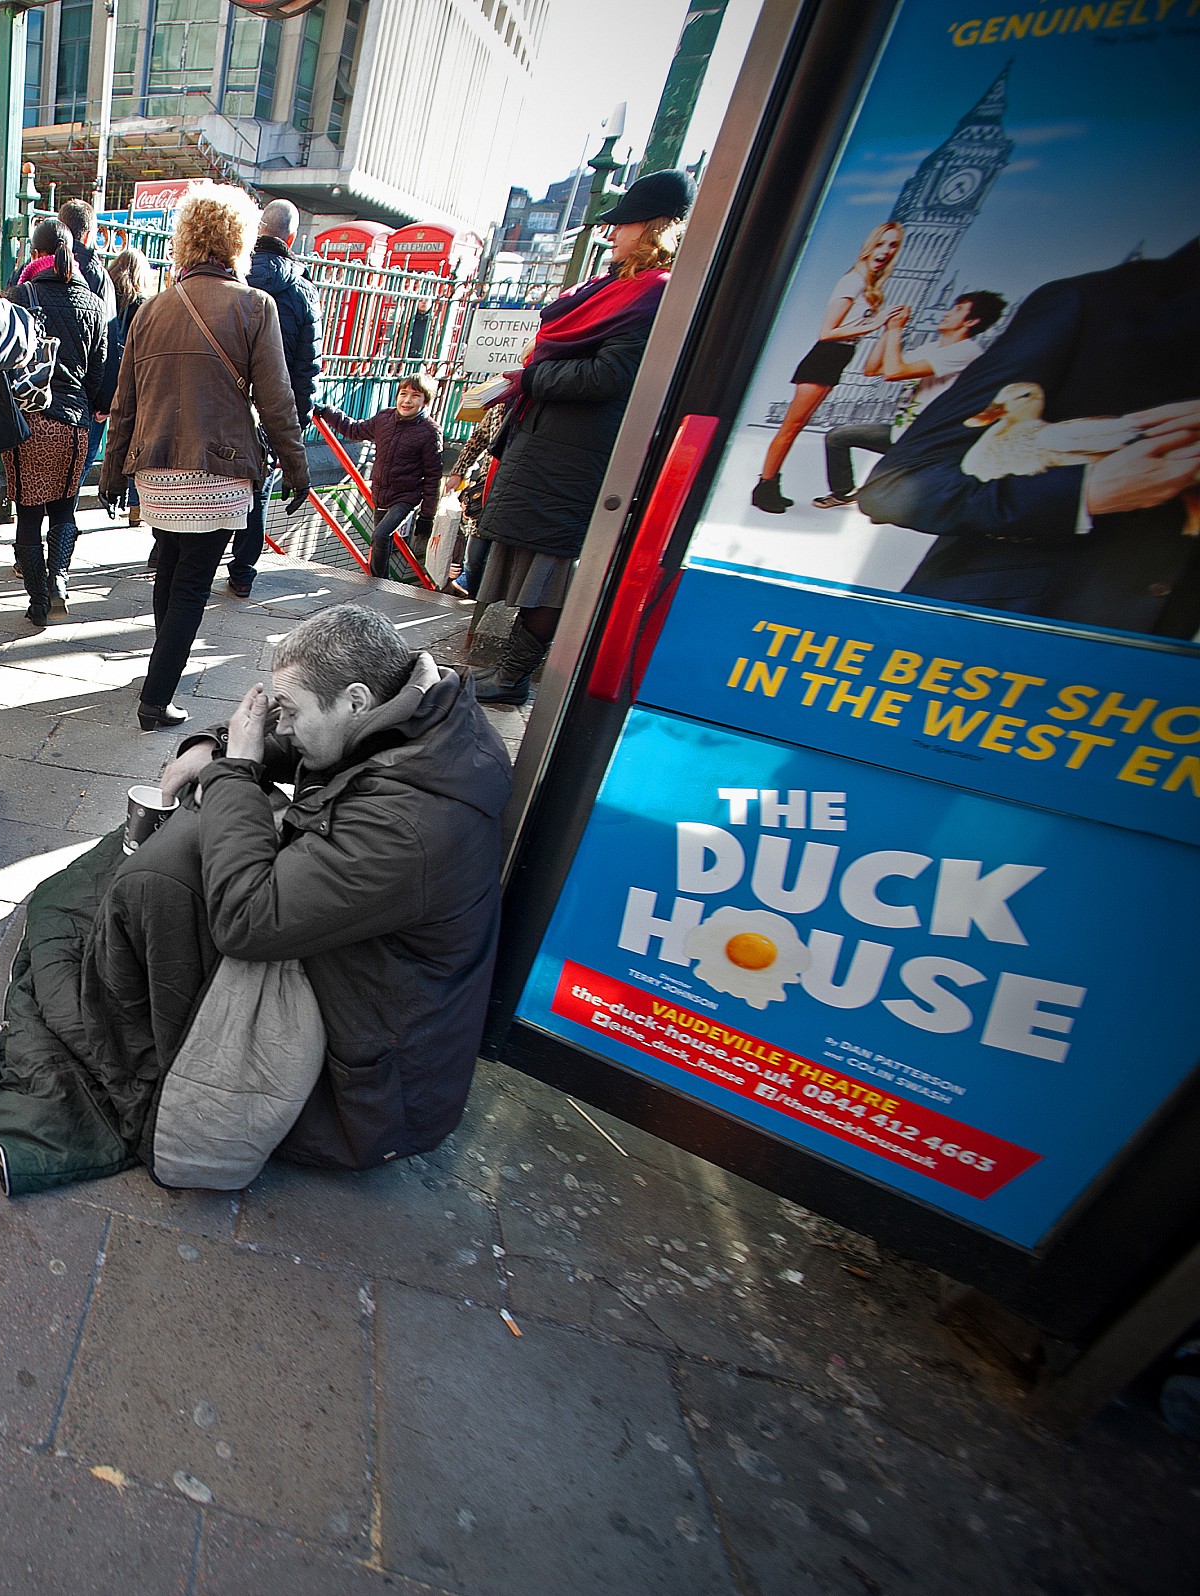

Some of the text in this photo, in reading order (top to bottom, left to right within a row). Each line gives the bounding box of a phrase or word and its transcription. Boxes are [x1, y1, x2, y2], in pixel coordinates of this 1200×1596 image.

[397, 243, 441, 251] TELEPHONE
[476, 336, 518, 347] COURT
[483, 320, 539, 331] TOTTENH
[879, 649, 1047, 708] BEST
[726, 657, 787, 698] IN
[801, 672, 912, 727] THE
[923, 700, 1116, 770] WEST
[718, 788, 847, 831] THE
[677, 821, 1047, 946] DUCK
[618, 886, 1088, 1063] HOUSE
[628, 968, 720, 1011] TERRY JOHNSON
[659, 972, 693, 989] Director
[571, 985, 997, 1173] the-duck-house.co.uk 0844 412 4663
[608, 1019, 746, 1086] @the_duck_house
[652, 1001, 901, 1115] VAUDEVILLE THEATRE
[823, 1050, 953, 1105] and COLIN SWASH
[824, 1036, 967, 1096] By DAN PATTERSON
